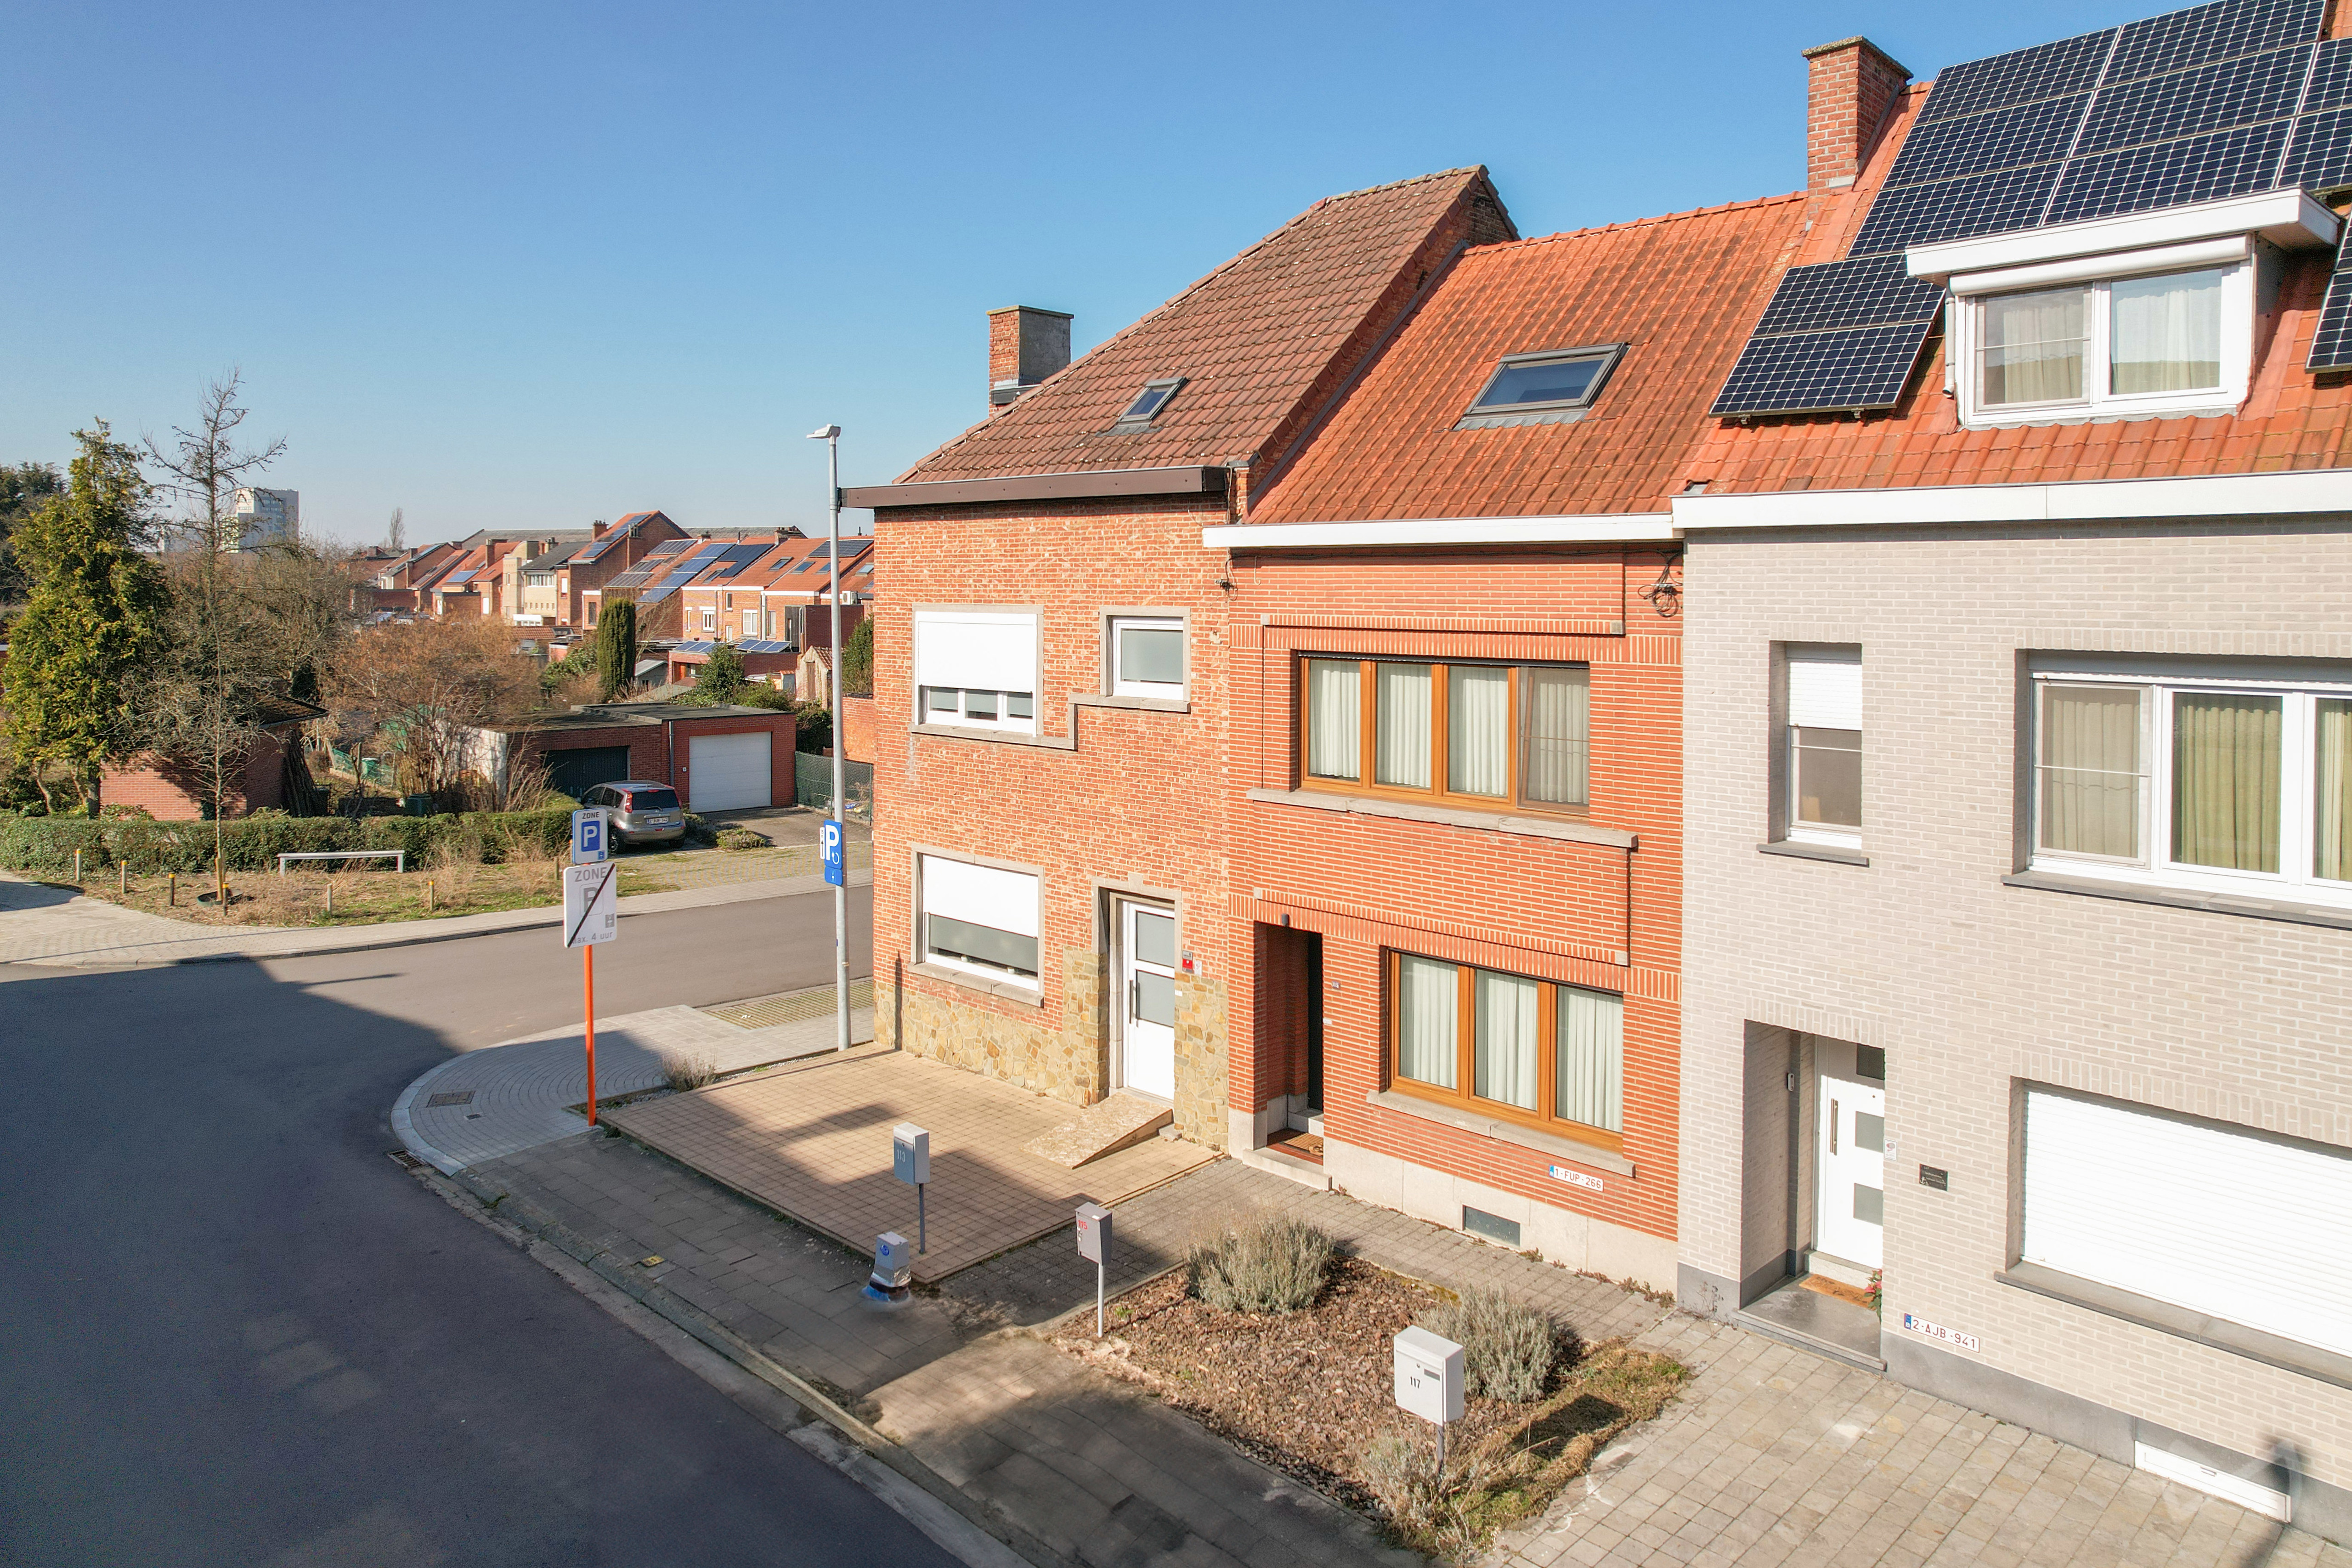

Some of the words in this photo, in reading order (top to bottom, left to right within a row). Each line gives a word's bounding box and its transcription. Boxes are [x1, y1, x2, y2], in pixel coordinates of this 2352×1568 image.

[583, 825, 597, 847] P
[825, 824, 839, 860] P
[575, 866, 607, 882] ZONE
[583, 887, 599, 912] P
[897, 1149, 905, 1162] 113
[1078, 1220, 1088, 1230] 115
[1410, 1376, 1420, 1389] 117
